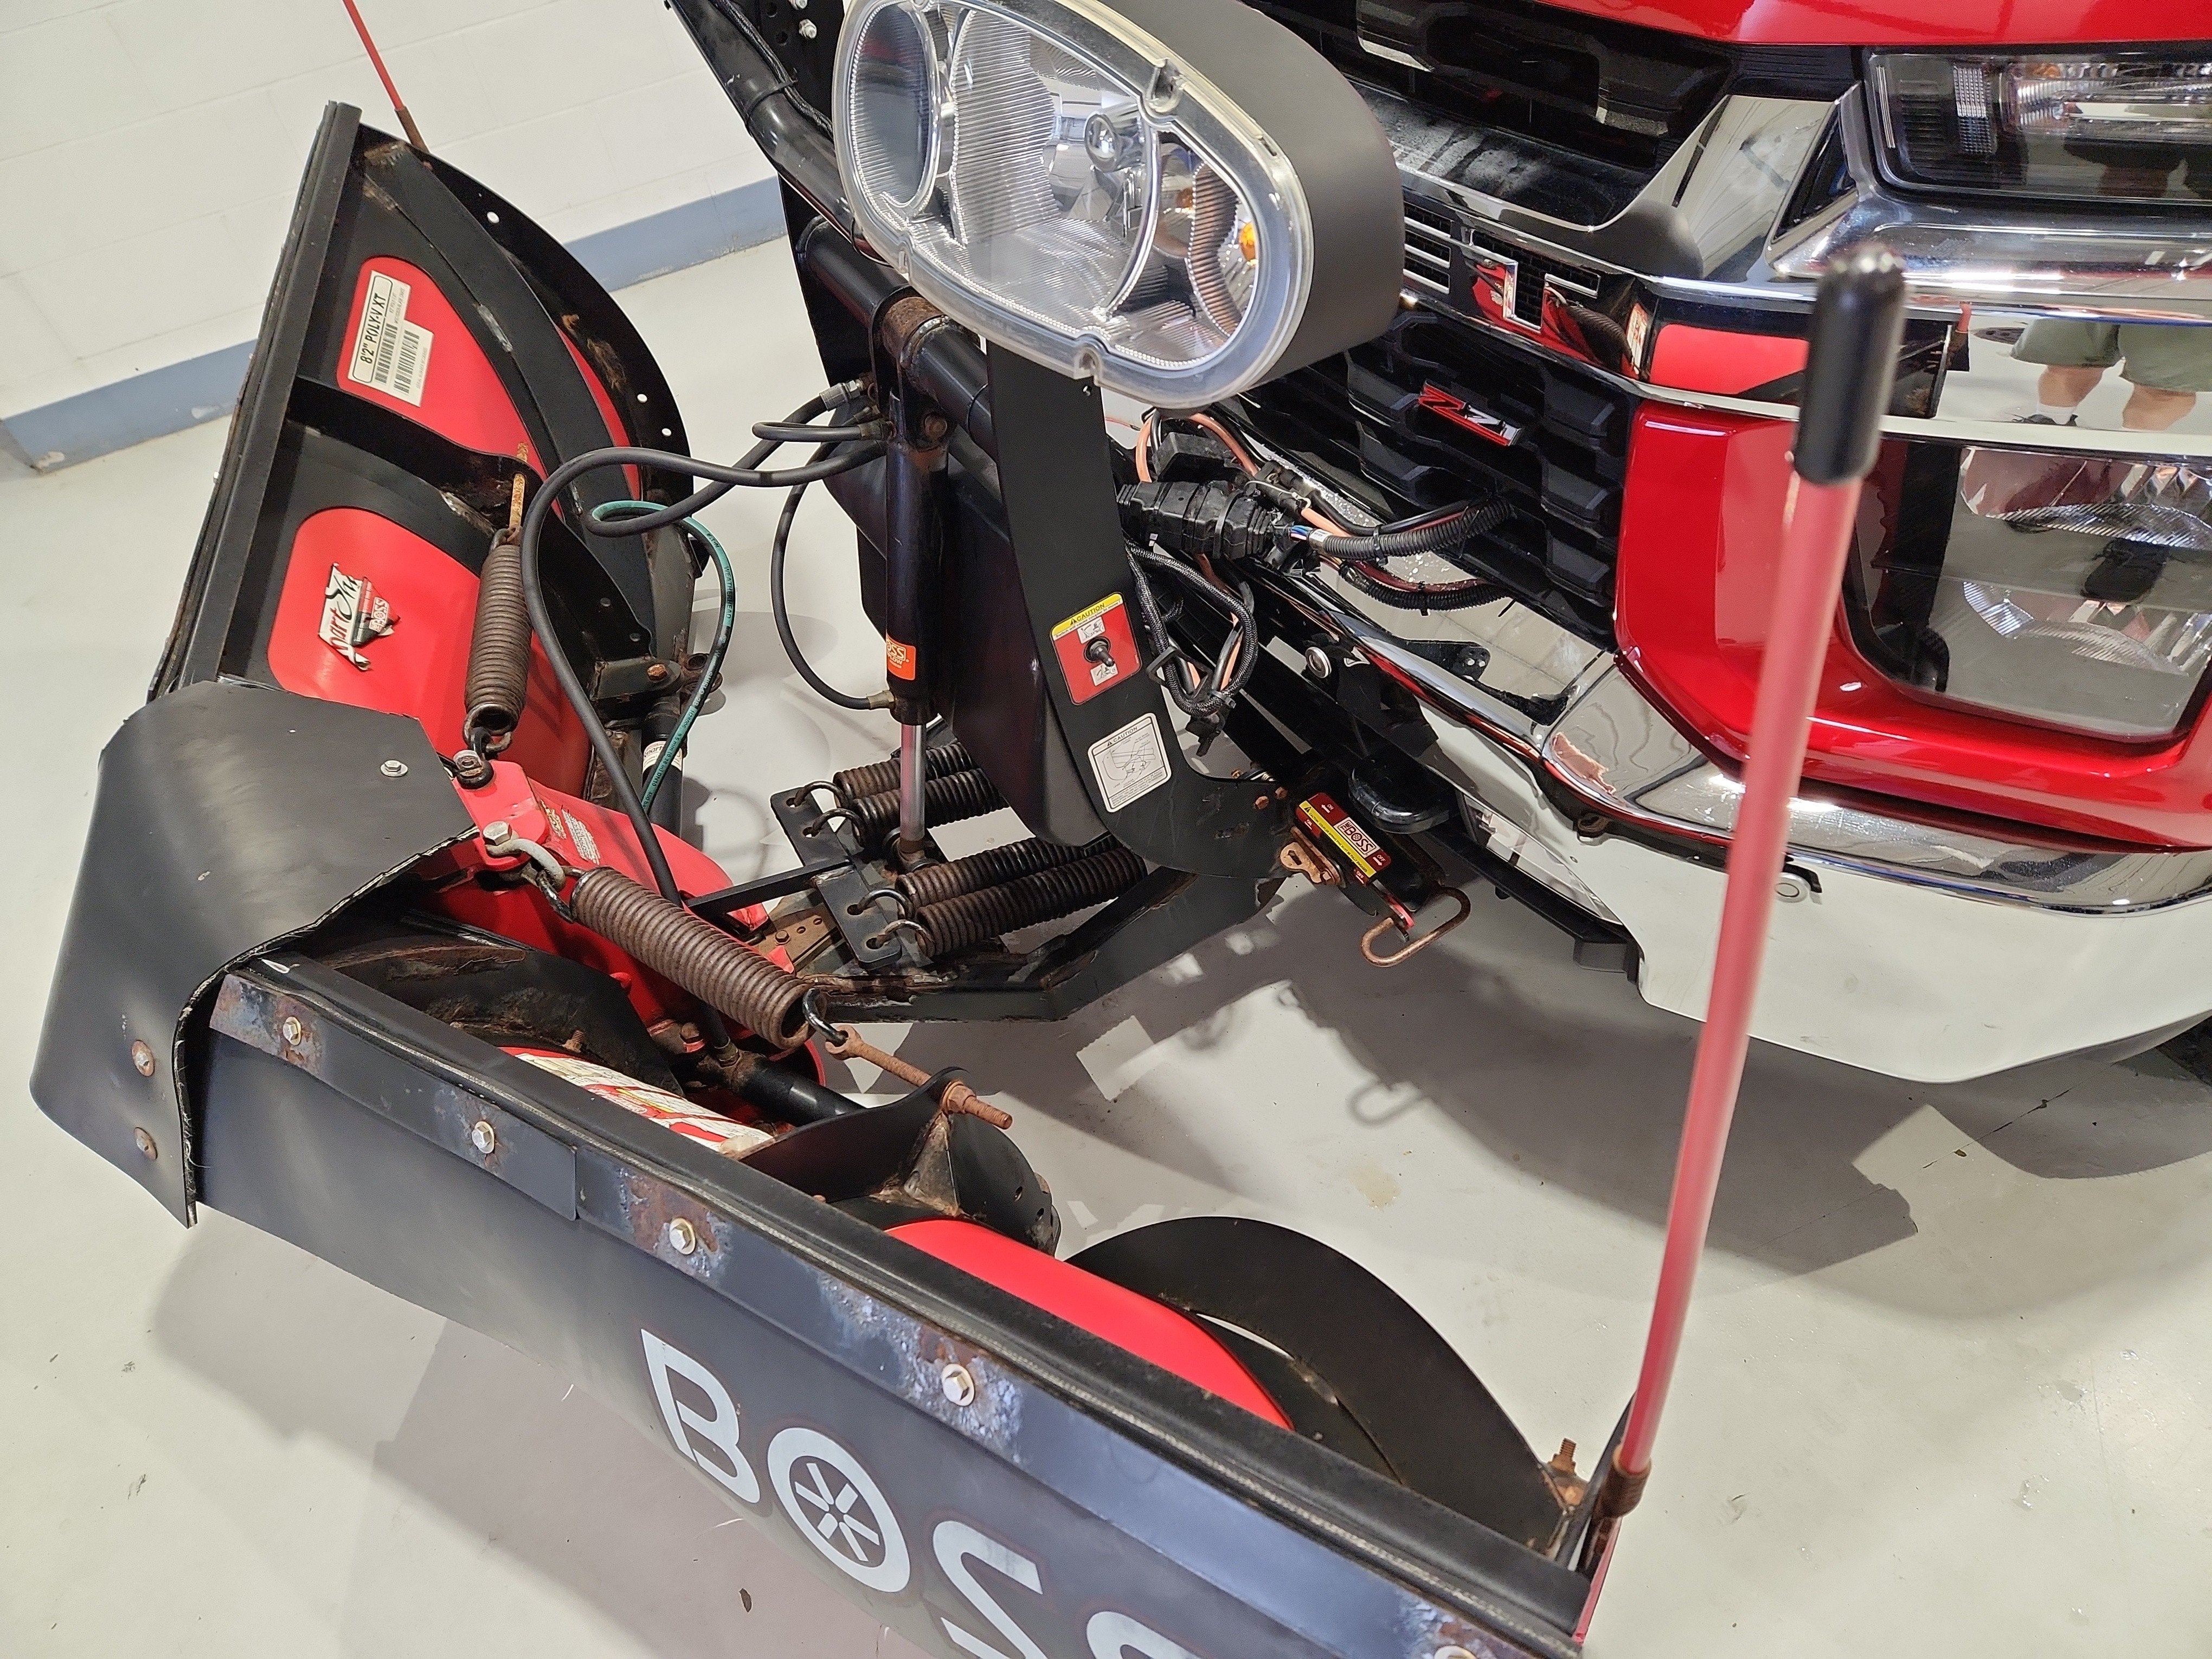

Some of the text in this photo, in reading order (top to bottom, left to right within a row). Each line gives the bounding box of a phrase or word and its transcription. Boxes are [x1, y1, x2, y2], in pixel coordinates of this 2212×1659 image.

[372, 292, 386, 309] XT
[365, 307, 383, 344] POLY-V
[724, 566, 732, 619] WEATHERHEAD
[1077, 603, 1105, 622] CAUTION
[886, 639, 904, 659] OSS
[1113, 726, 1138, 742] CAUTION
[1340, 821, 1352, 831] THE
[1344, 827, 1373, 852] BOSS
[1356, 871, 1364, 879] OFF
